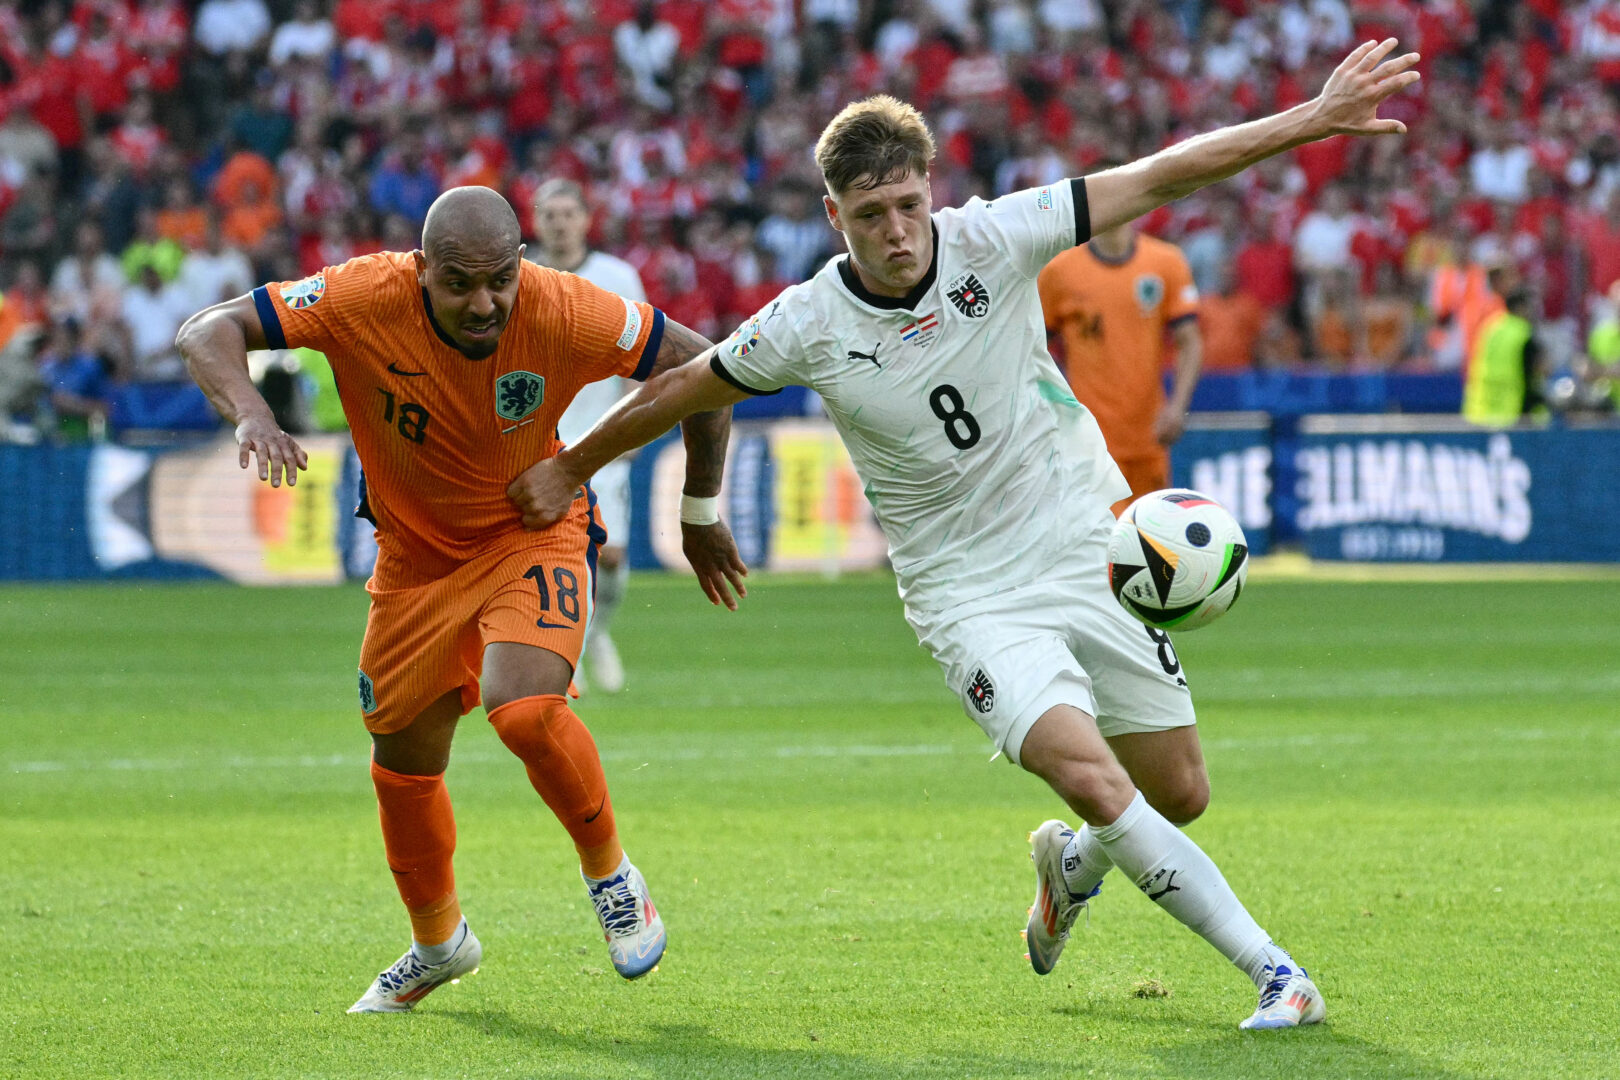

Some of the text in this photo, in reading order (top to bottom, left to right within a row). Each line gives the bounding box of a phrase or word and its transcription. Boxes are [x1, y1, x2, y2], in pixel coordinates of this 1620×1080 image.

[376, 386, 430, 446] 18
[929, 384, 981, 451] 8
[522, 564, 580, 624] 18
[1143, 623, 1180, 676] 8
